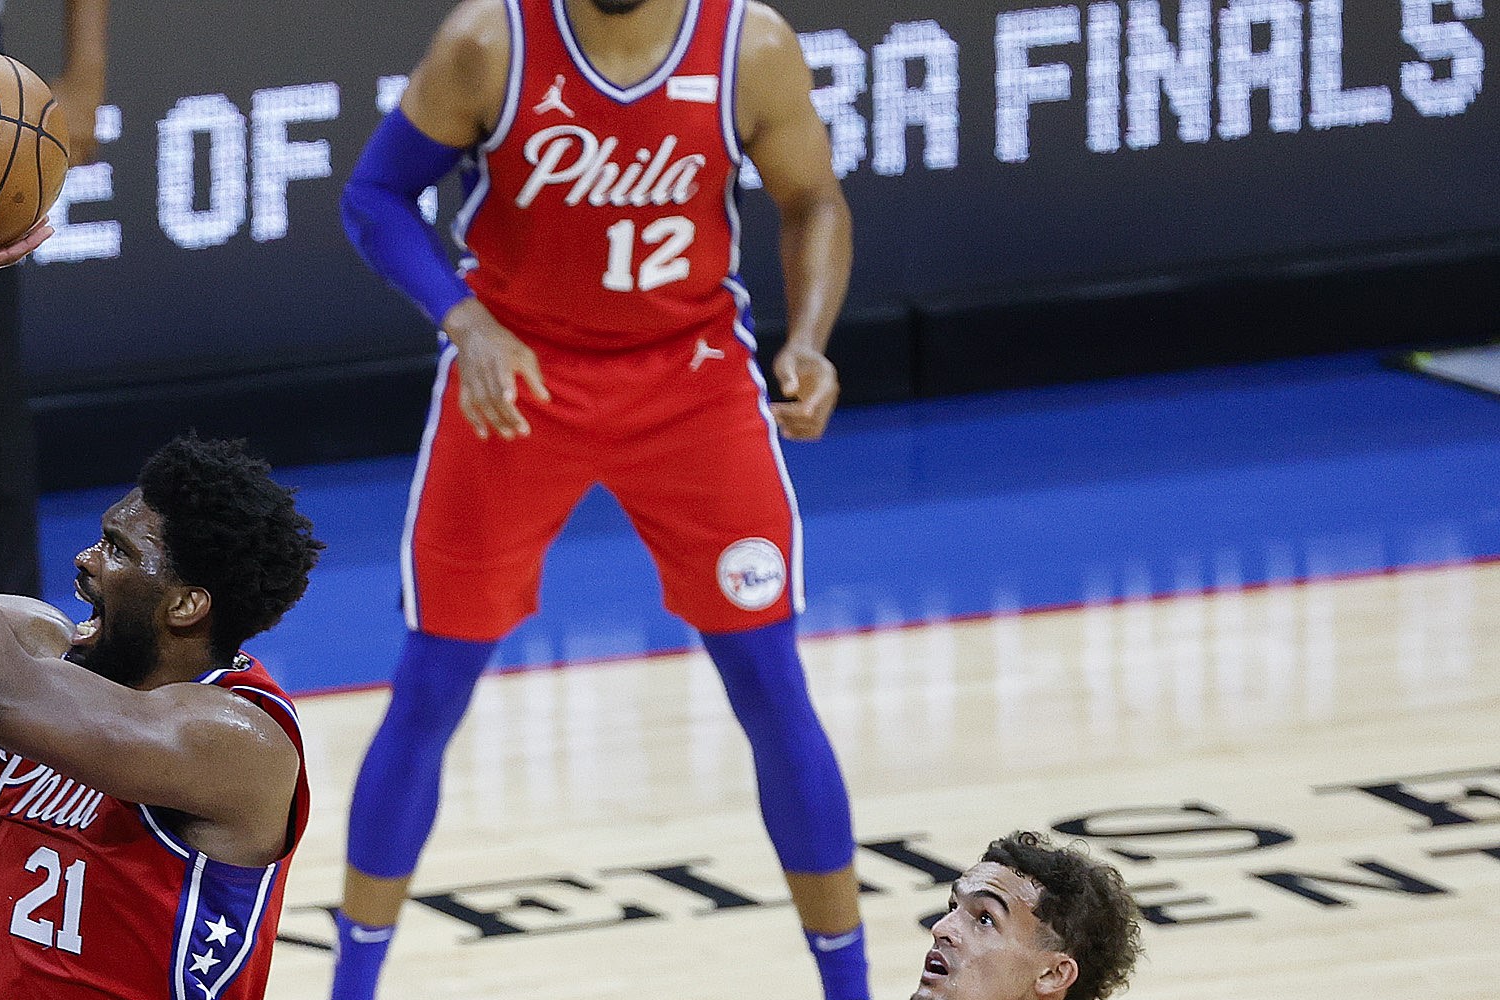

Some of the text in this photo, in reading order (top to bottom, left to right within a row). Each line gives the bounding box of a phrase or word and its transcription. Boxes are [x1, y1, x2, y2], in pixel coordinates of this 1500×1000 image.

[156, 80, 341, 250] OF
[739, 18, 960, 190] BA
[994, 0, 1486, 163] FINALS
[515, 124, 707, 209] Phila
[601, 214, 697, 293] 12
[9, 845, 87, 955] 21
